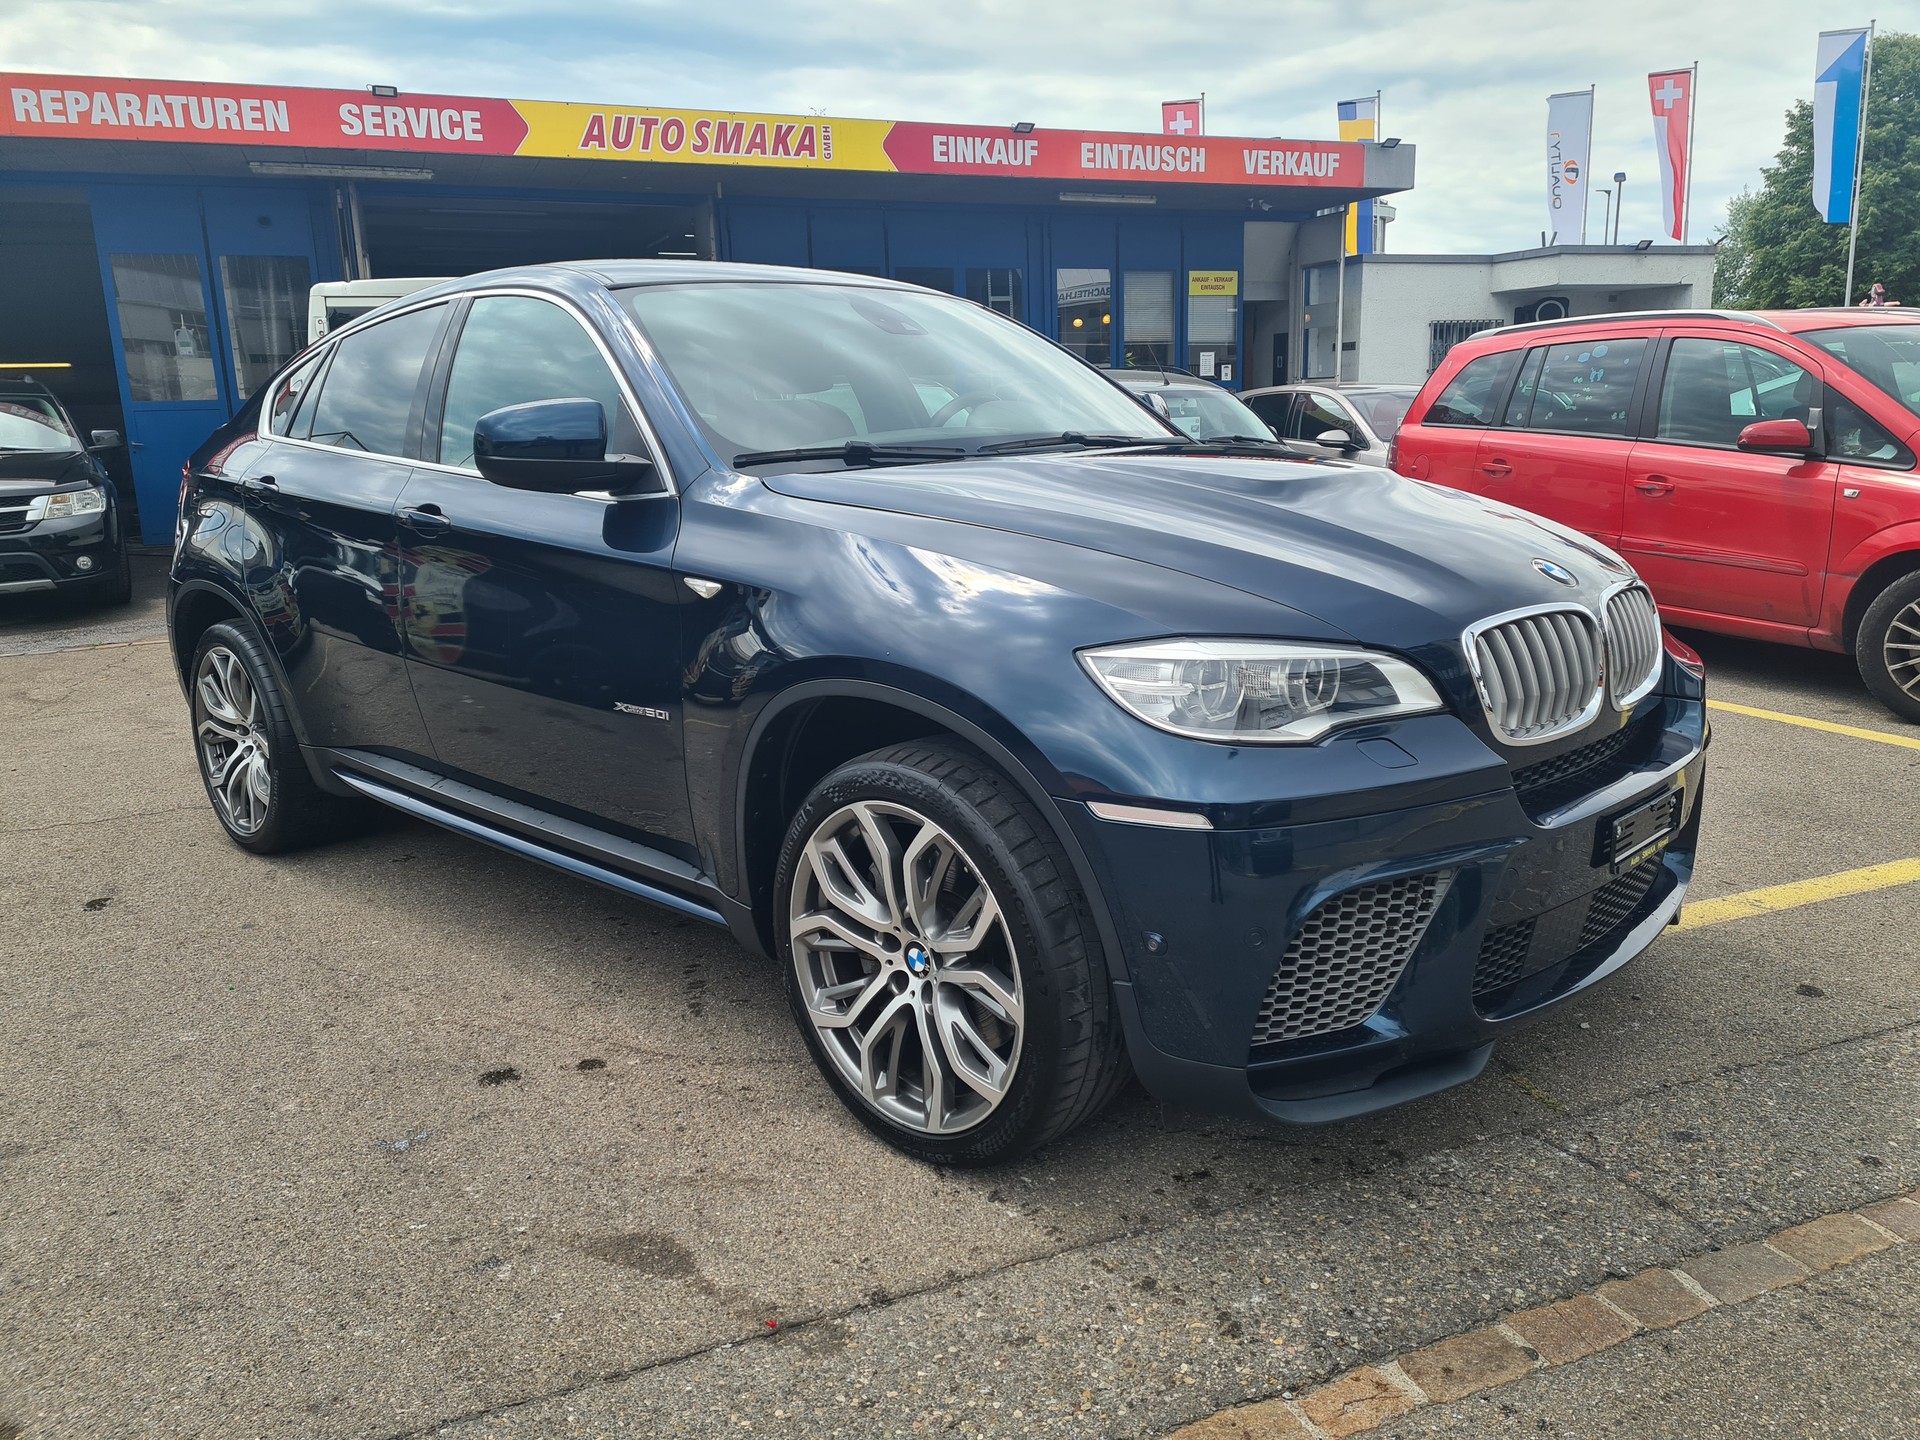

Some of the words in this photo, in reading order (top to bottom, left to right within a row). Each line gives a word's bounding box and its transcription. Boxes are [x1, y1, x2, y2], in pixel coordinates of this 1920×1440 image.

[10, 88, 290, 132] REPARATUREN
[339, 102, 484, 142] SERVICE
[579, 113, 687, 153] AUTO
[691, 119, 817, 160] SMAKA
[821, 125, 832, 160] GMBH
[932, 135, 1038, 166] EINKAUF
[1080, 142, 1206, 173] EINTAUSCH
[1243, 149, 1340, 177] VERKAUF
